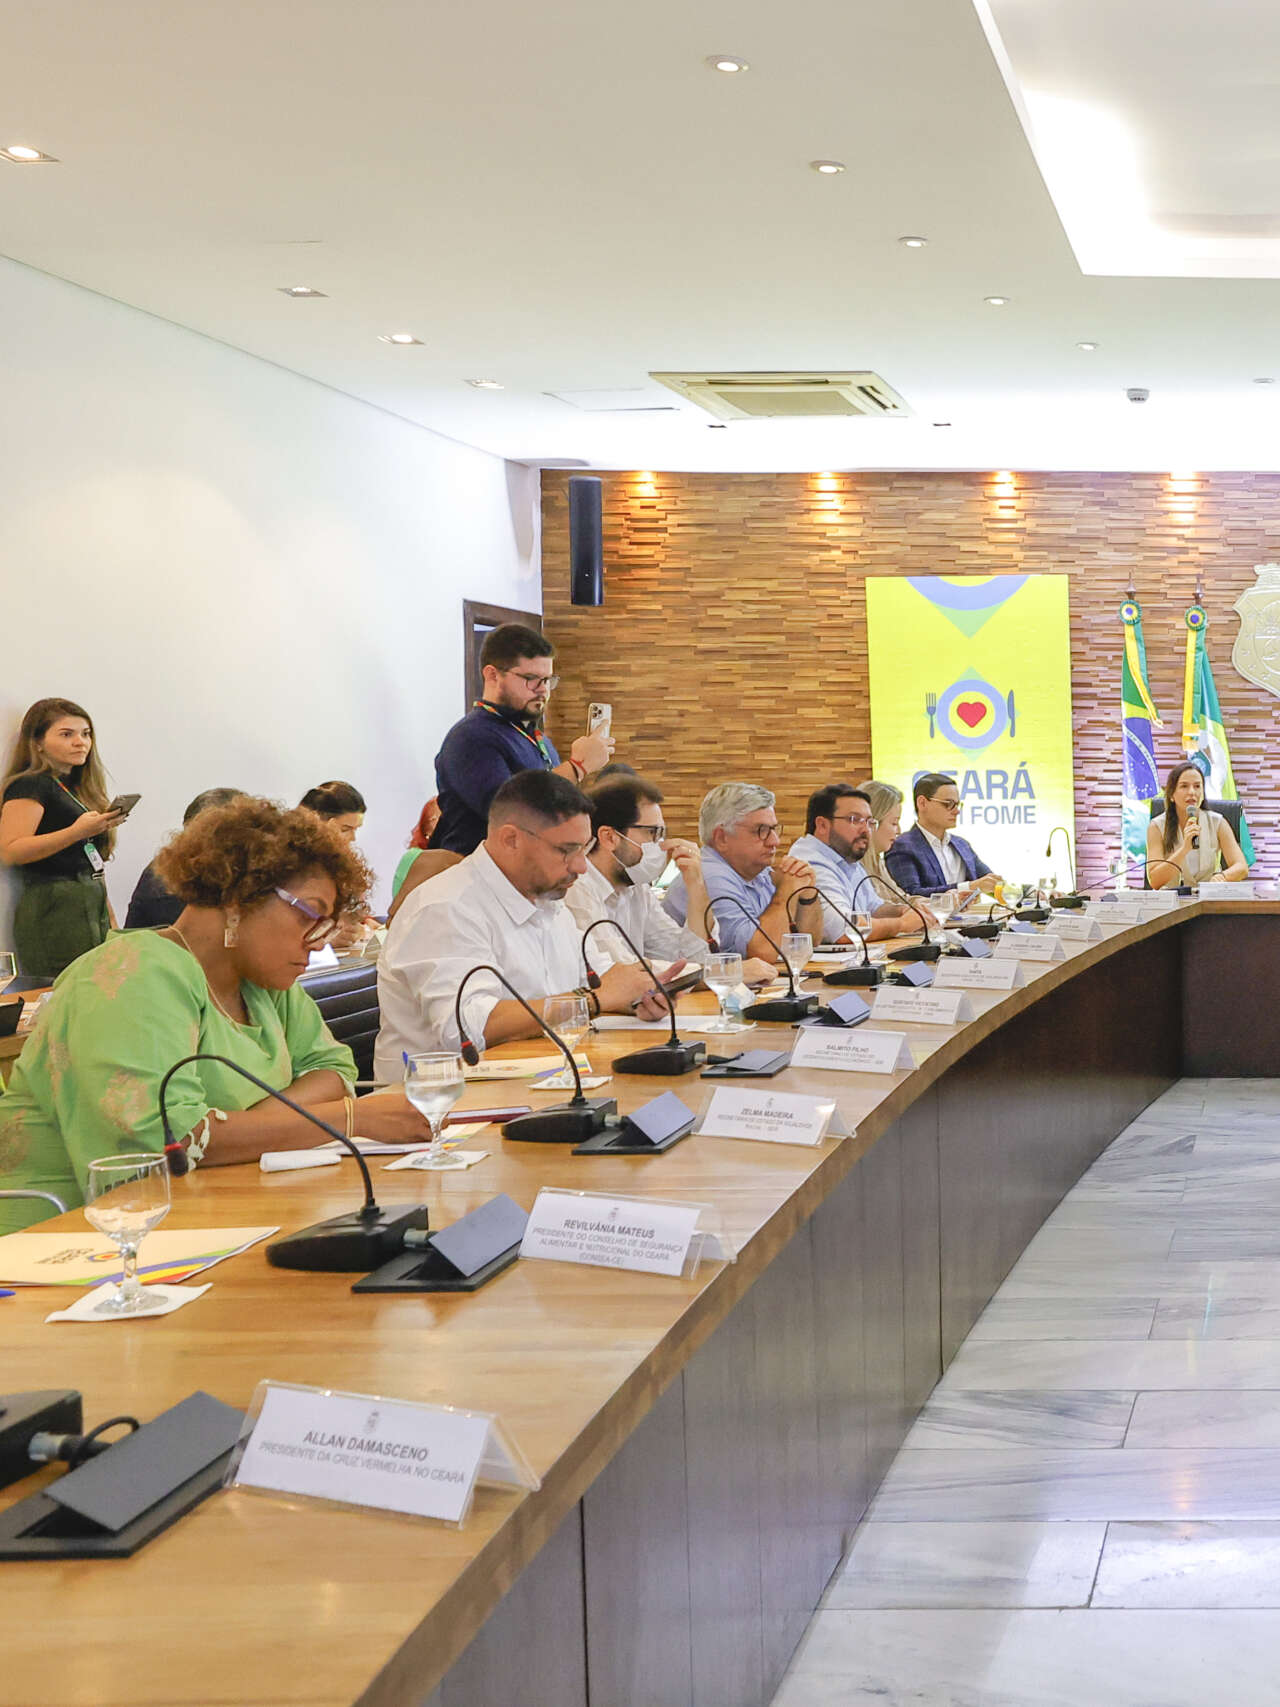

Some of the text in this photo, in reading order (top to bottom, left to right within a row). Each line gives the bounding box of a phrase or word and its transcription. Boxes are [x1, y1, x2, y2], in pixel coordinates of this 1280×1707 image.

[912, 761, 1036, 800] ARÁ
[971, 805, 1036, 825] FOME
[617, 1225, 655, 1239] MATEUS
[259, 1441, 316, 1460] PRESIDENTE
[317, 1450, 331, 1461] DA
[333, 1453, 360, 1468] CRUZ
[412, 1466, 429, 1479] NO
[303, 1431, 429, 1461] ALLAN DAMASCENO
